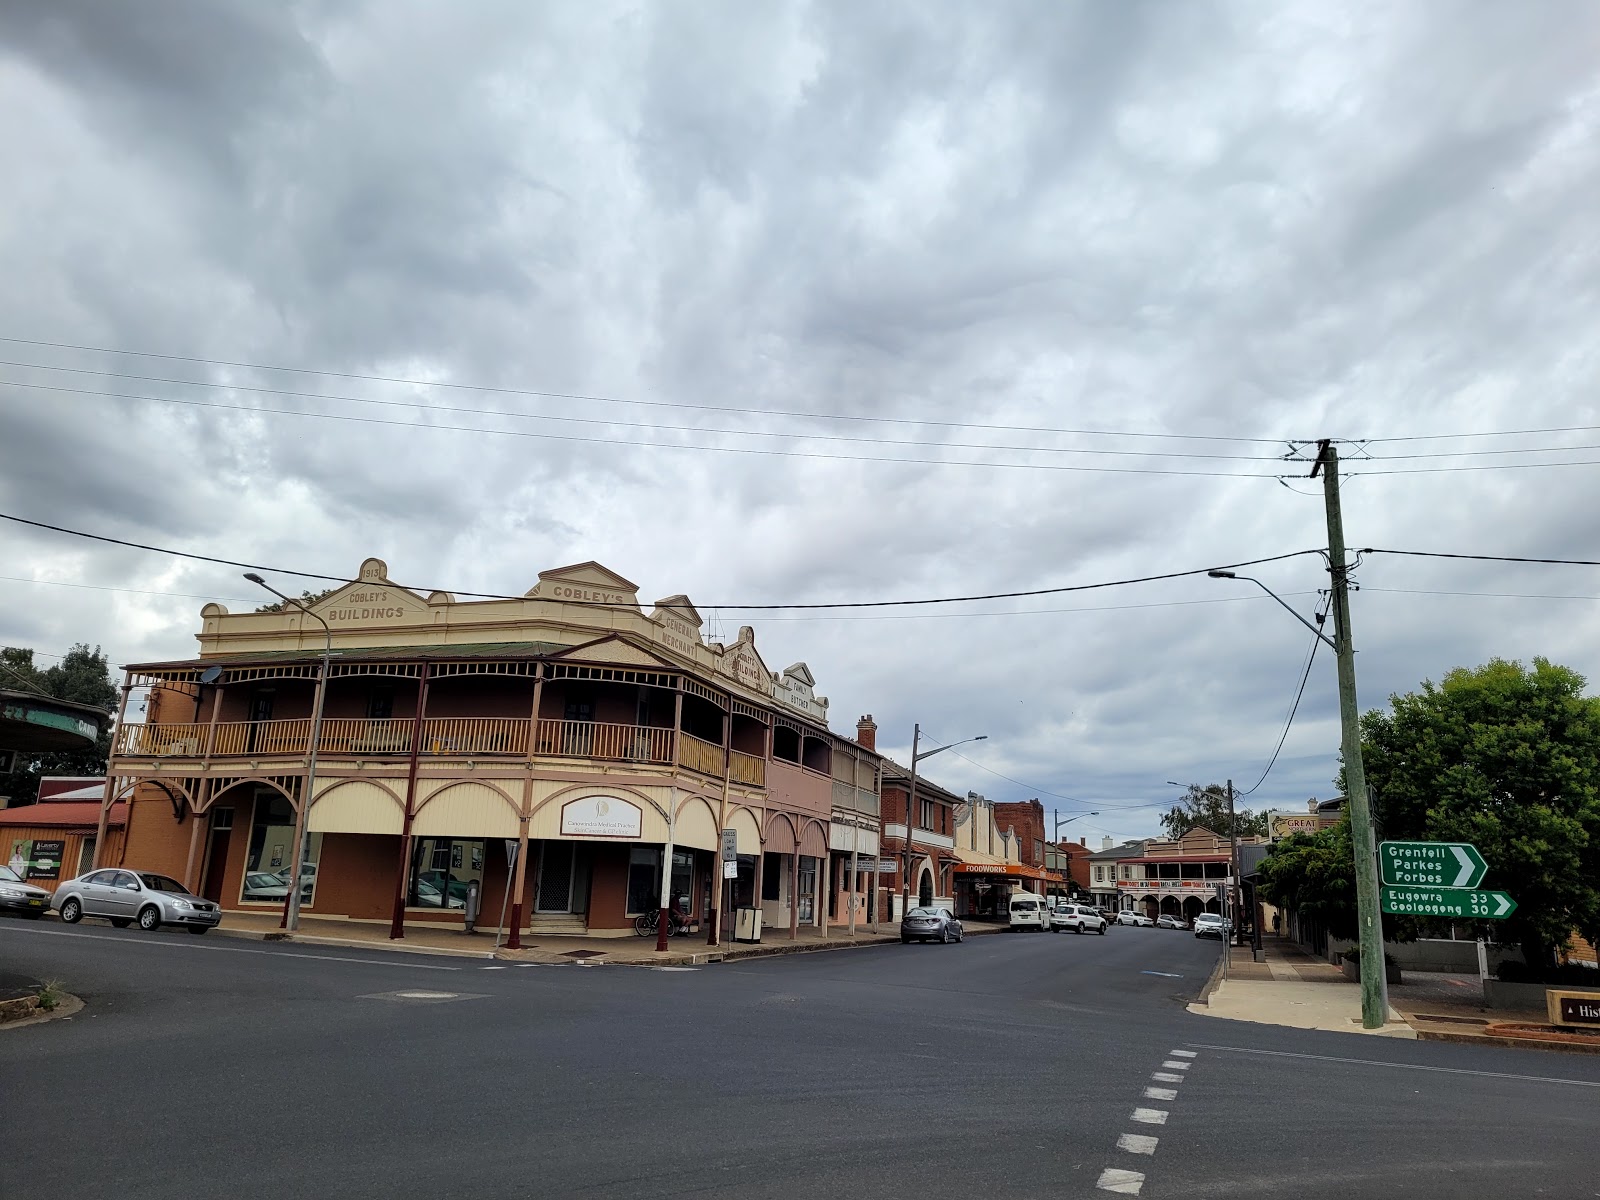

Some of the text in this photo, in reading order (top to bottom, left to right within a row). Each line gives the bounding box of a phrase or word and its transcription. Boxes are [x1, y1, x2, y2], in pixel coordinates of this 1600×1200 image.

[363, 569, 379, 578] 1913
[350, 592, 387, 603] COBLEY'S
[553, 586, 623, 604] COBLEY'S
[329, 607, 404, 621] BUILDINGS
[666, 617, 693, 639] GENERAL
[662, 632, 695, 656] MERCHANT
[1287, 819, 1316, 827] GREAT
[1388, 846, 1445, 859] Grenfell
[966, 864, 1007, 873] FOODWORKS
[1393, 859, 1443, 871] Parkes
[1395, 871, 1443, 884] Forbes
[1388, 890, 1488, 904] Eugowra 33
[1390, 901, 1489, 915] Gooloogong 30
